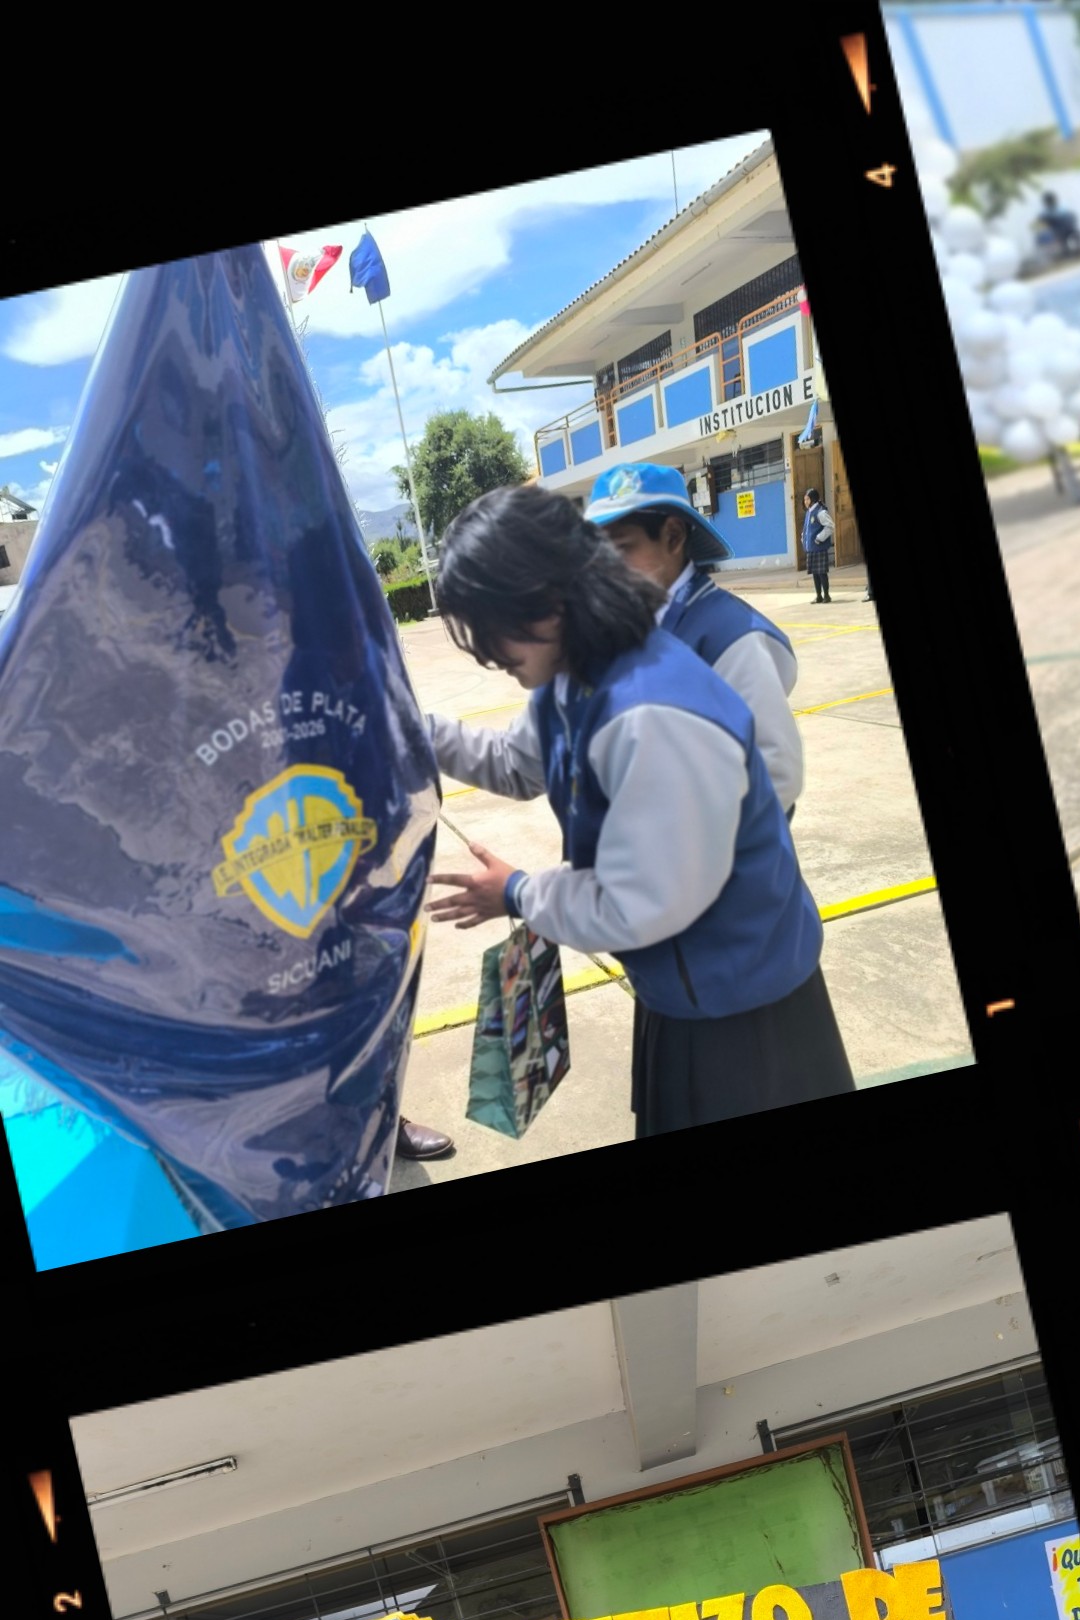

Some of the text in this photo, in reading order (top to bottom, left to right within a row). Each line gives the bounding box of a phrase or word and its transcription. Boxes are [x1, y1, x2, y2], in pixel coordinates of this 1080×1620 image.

[700, 384, 793, 436] INSTITUCION
[195, 691, 367, 767] BODAS DE PLATA
[267, 938, 352, 995] SICUANI
